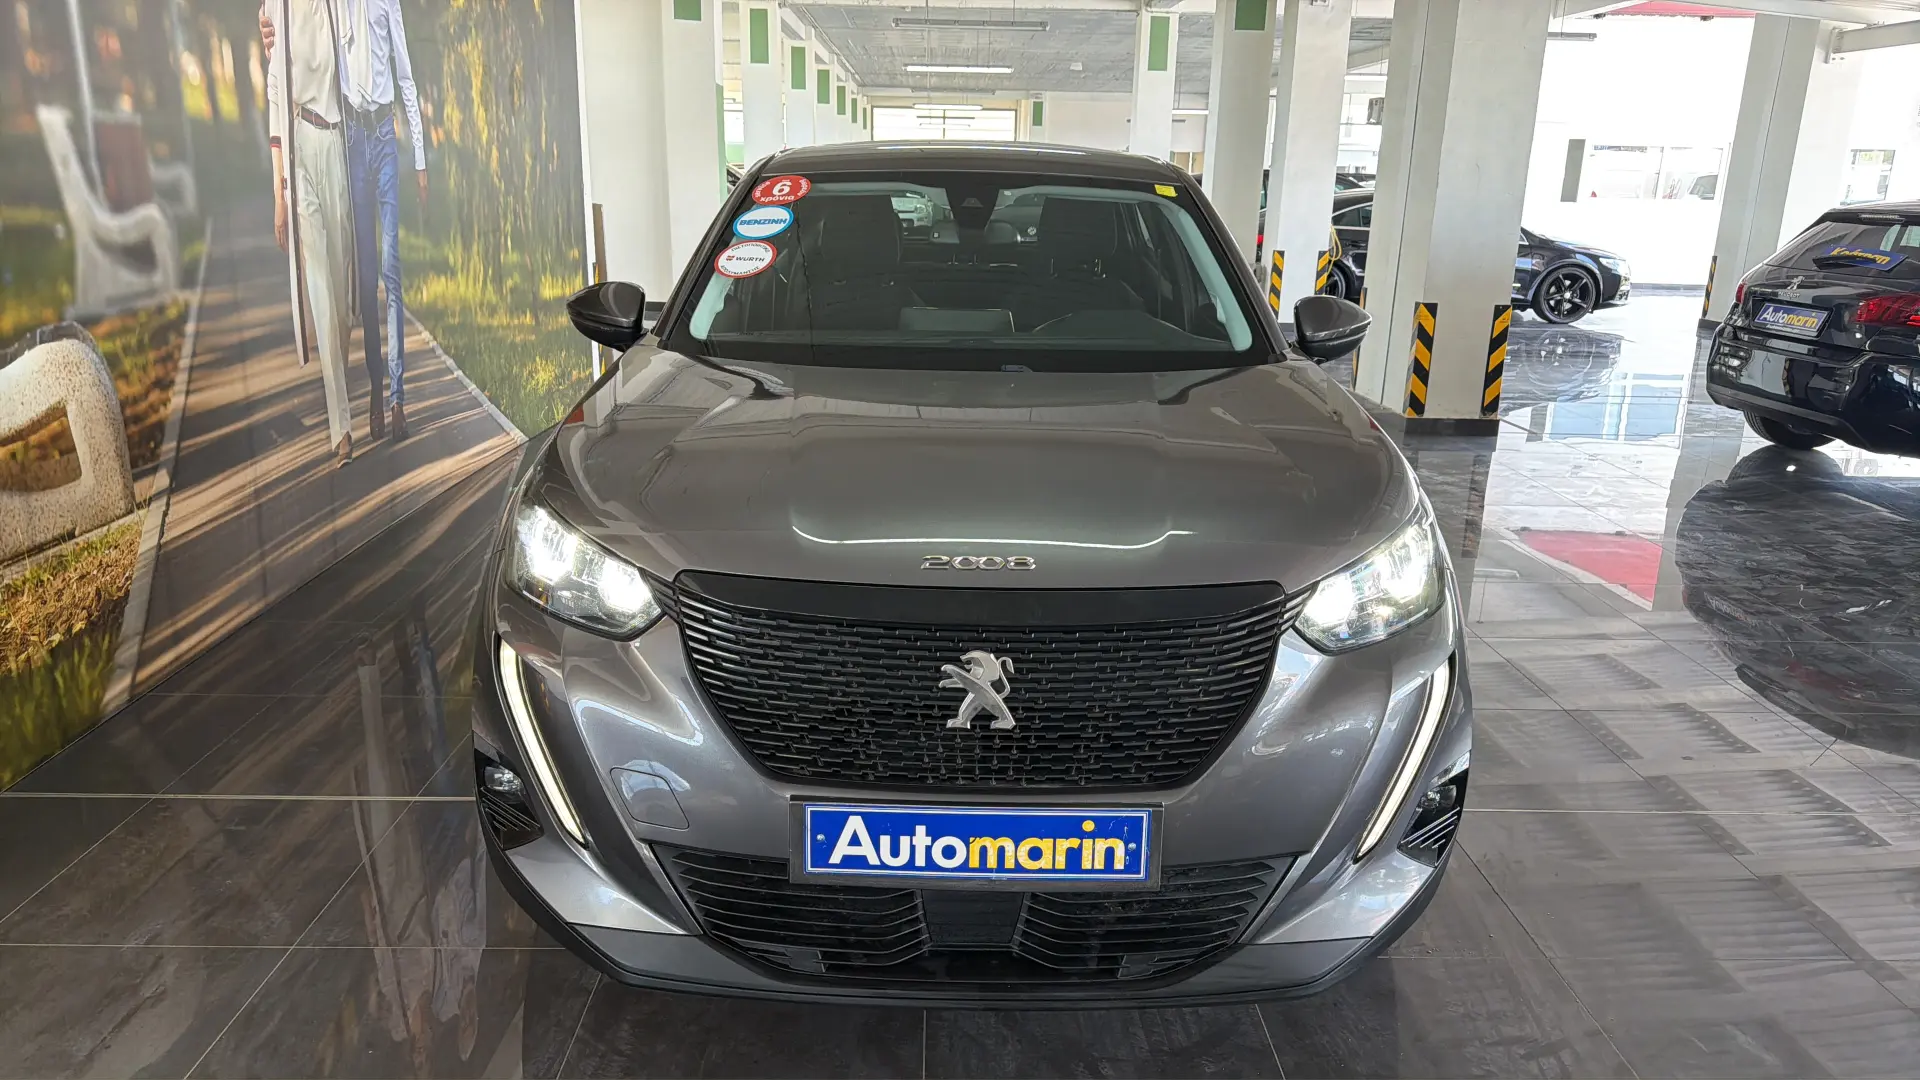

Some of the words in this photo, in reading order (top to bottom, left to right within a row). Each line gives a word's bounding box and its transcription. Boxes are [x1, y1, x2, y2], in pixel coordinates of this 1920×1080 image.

[772, 181, 792, 195] 6
[1760, 306, 1818, 327] Automarin
[920, 555, 1036, 570] 2008
[828, 815, 1125, 870] Automarin
